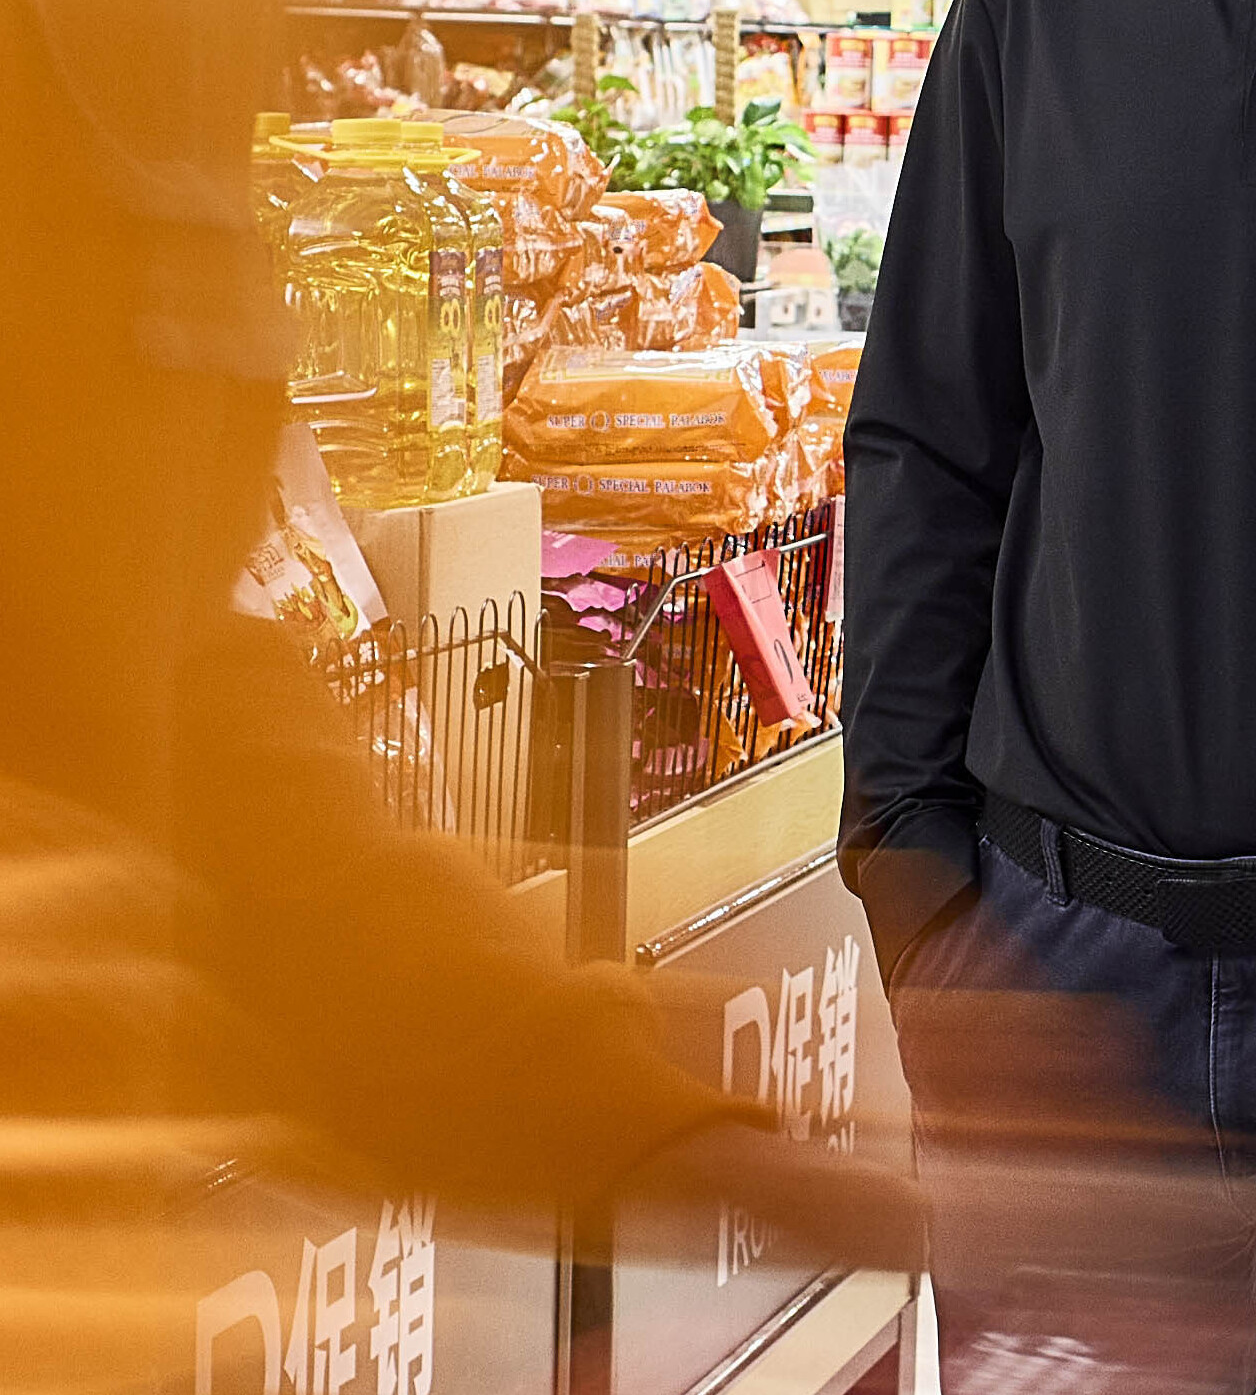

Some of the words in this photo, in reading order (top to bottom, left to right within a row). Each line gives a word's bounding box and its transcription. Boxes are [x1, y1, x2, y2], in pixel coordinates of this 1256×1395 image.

[547, 414, 586, 428] SUPER
[615, 413, 666, 428] SPECIAL
[599, 478, 650, 493] SPECIAL
